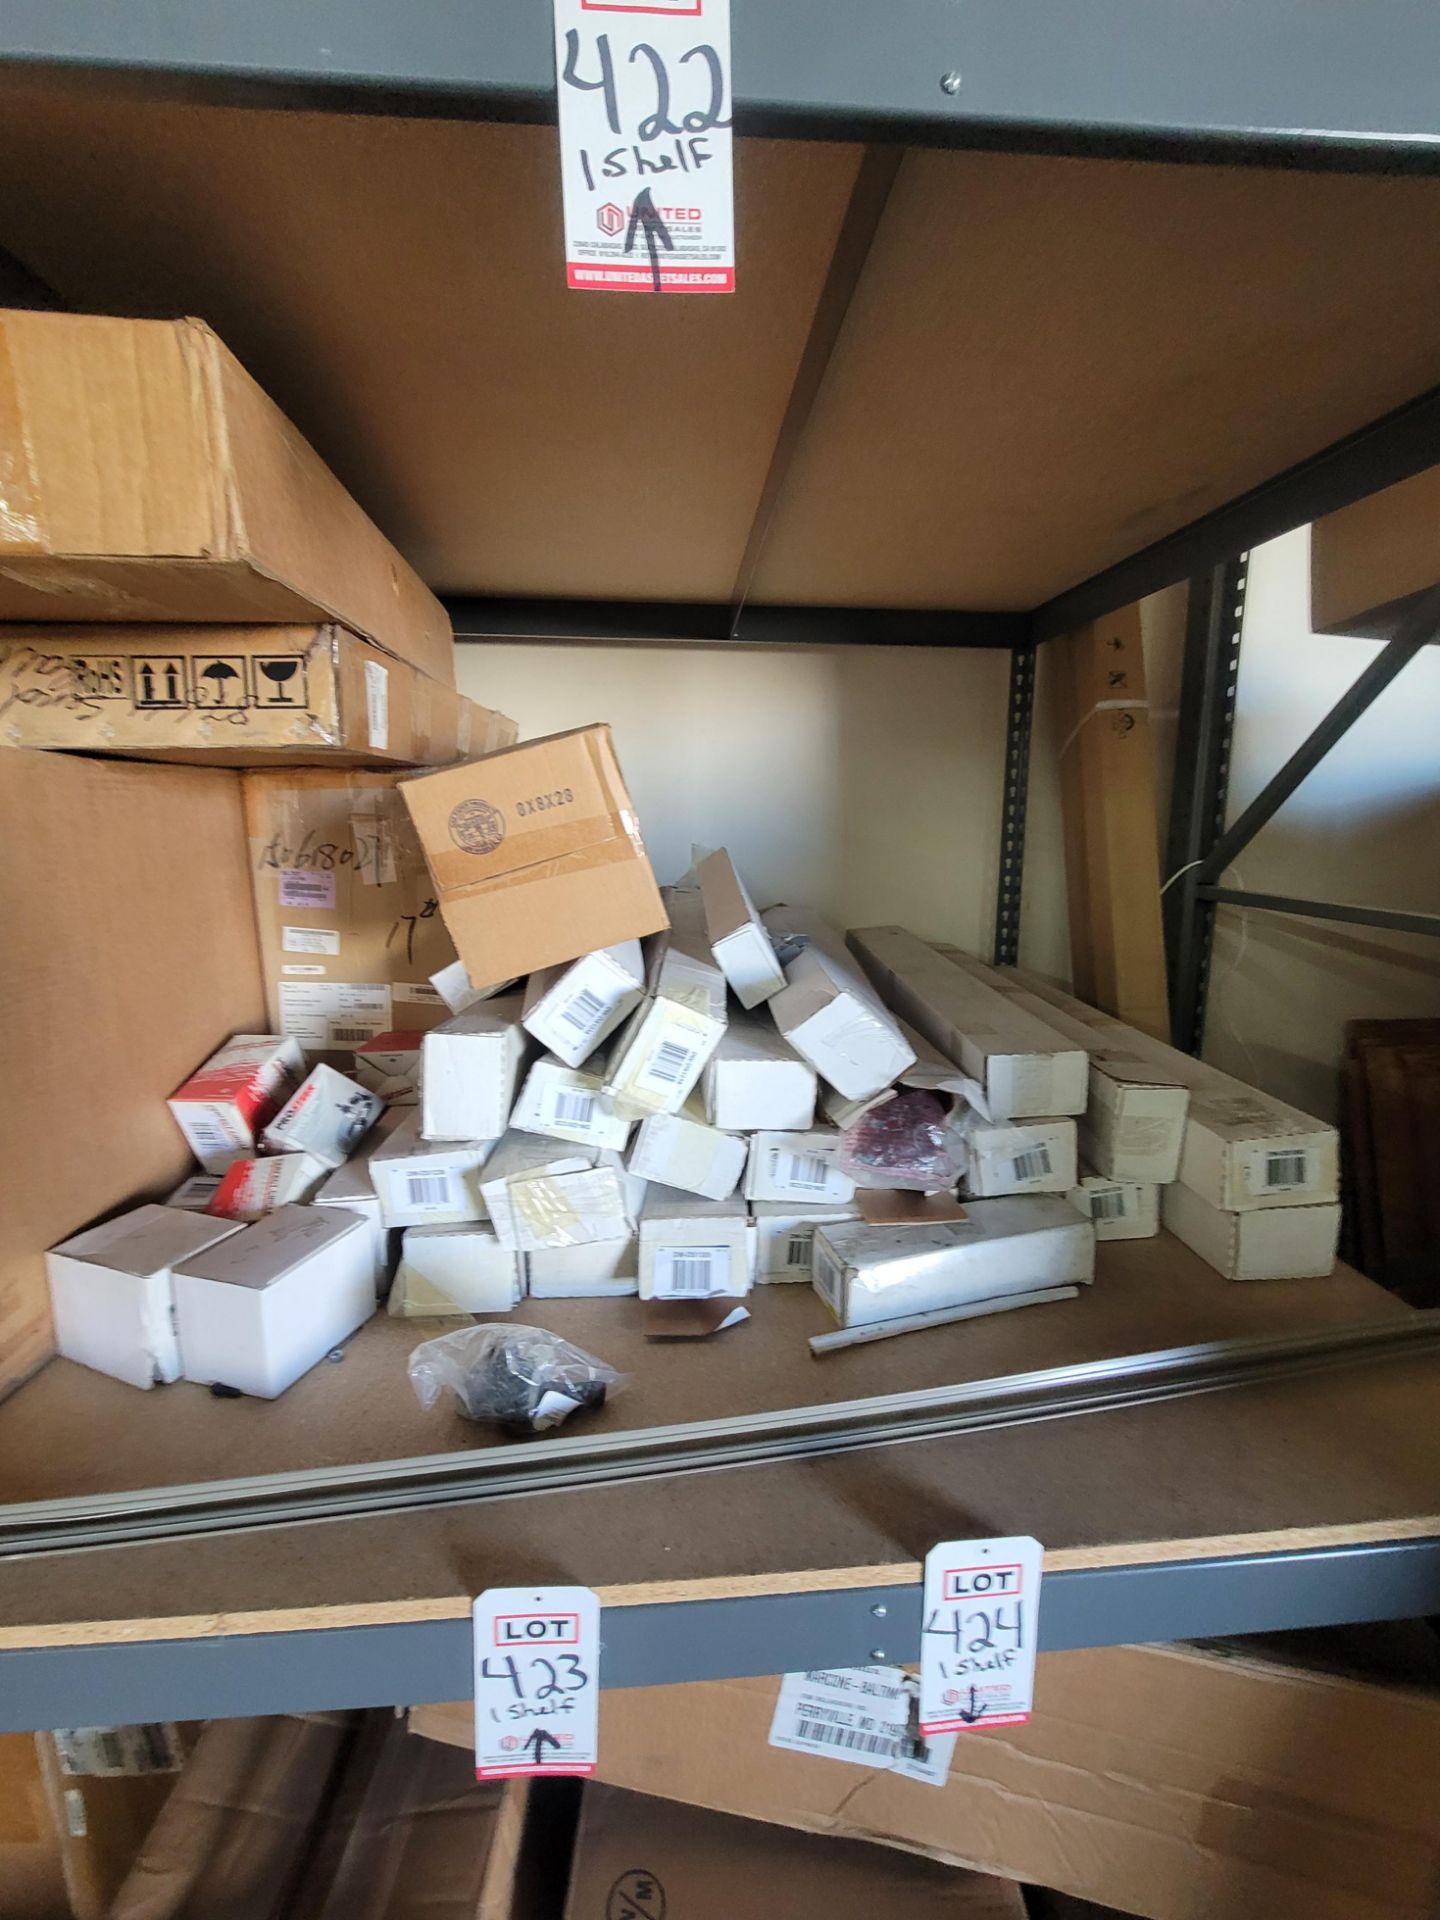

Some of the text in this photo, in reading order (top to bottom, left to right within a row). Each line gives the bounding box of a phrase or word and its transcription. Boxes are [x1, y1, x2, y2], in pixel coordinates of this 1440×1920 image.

[563, 28, 732, 141] 422
[580, 149, 595, 191] 1
[954, 1571, 1013, 1594] LOT
[506, 1619, 569, 1640] LOT
[924, 1600, 1023, 1654] 424
[482, 1654, 588, 1699] 423
[939, 1661, 948, 1679] 1
